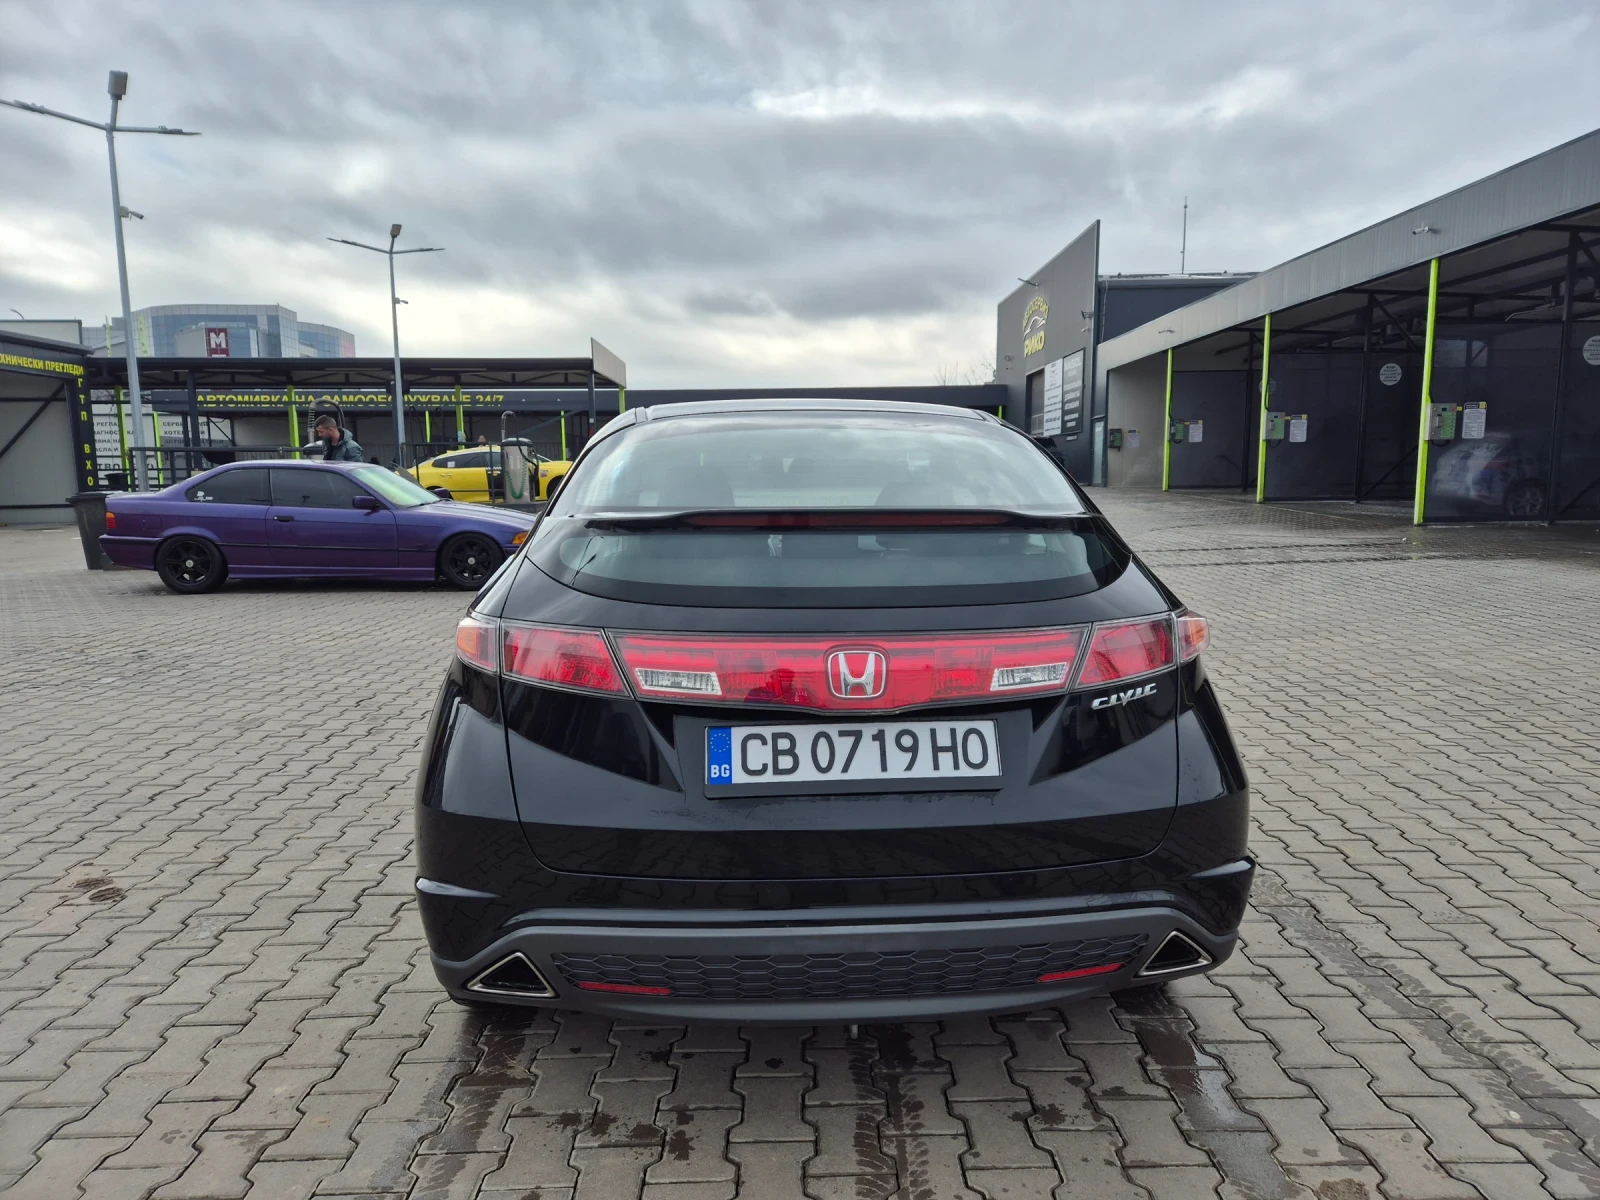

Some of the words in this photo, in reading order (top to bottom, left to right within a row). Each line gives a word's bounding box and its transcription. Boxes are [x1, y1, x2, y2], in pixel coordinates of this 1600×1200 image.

[45, 361, 84, 376] ПРЕГЛЕДИ
[197, 394, 289, 407] АВТОМИВКА
[475, 394, 504, 407] 24/7
[1091, 683, 1157, 710] CIVIC
[741, 732, 800, 776] CB
[811, 729, 919, 774] 0719
[930, 727, 989, 770] HO
[710, 764, 730, 778] BG
